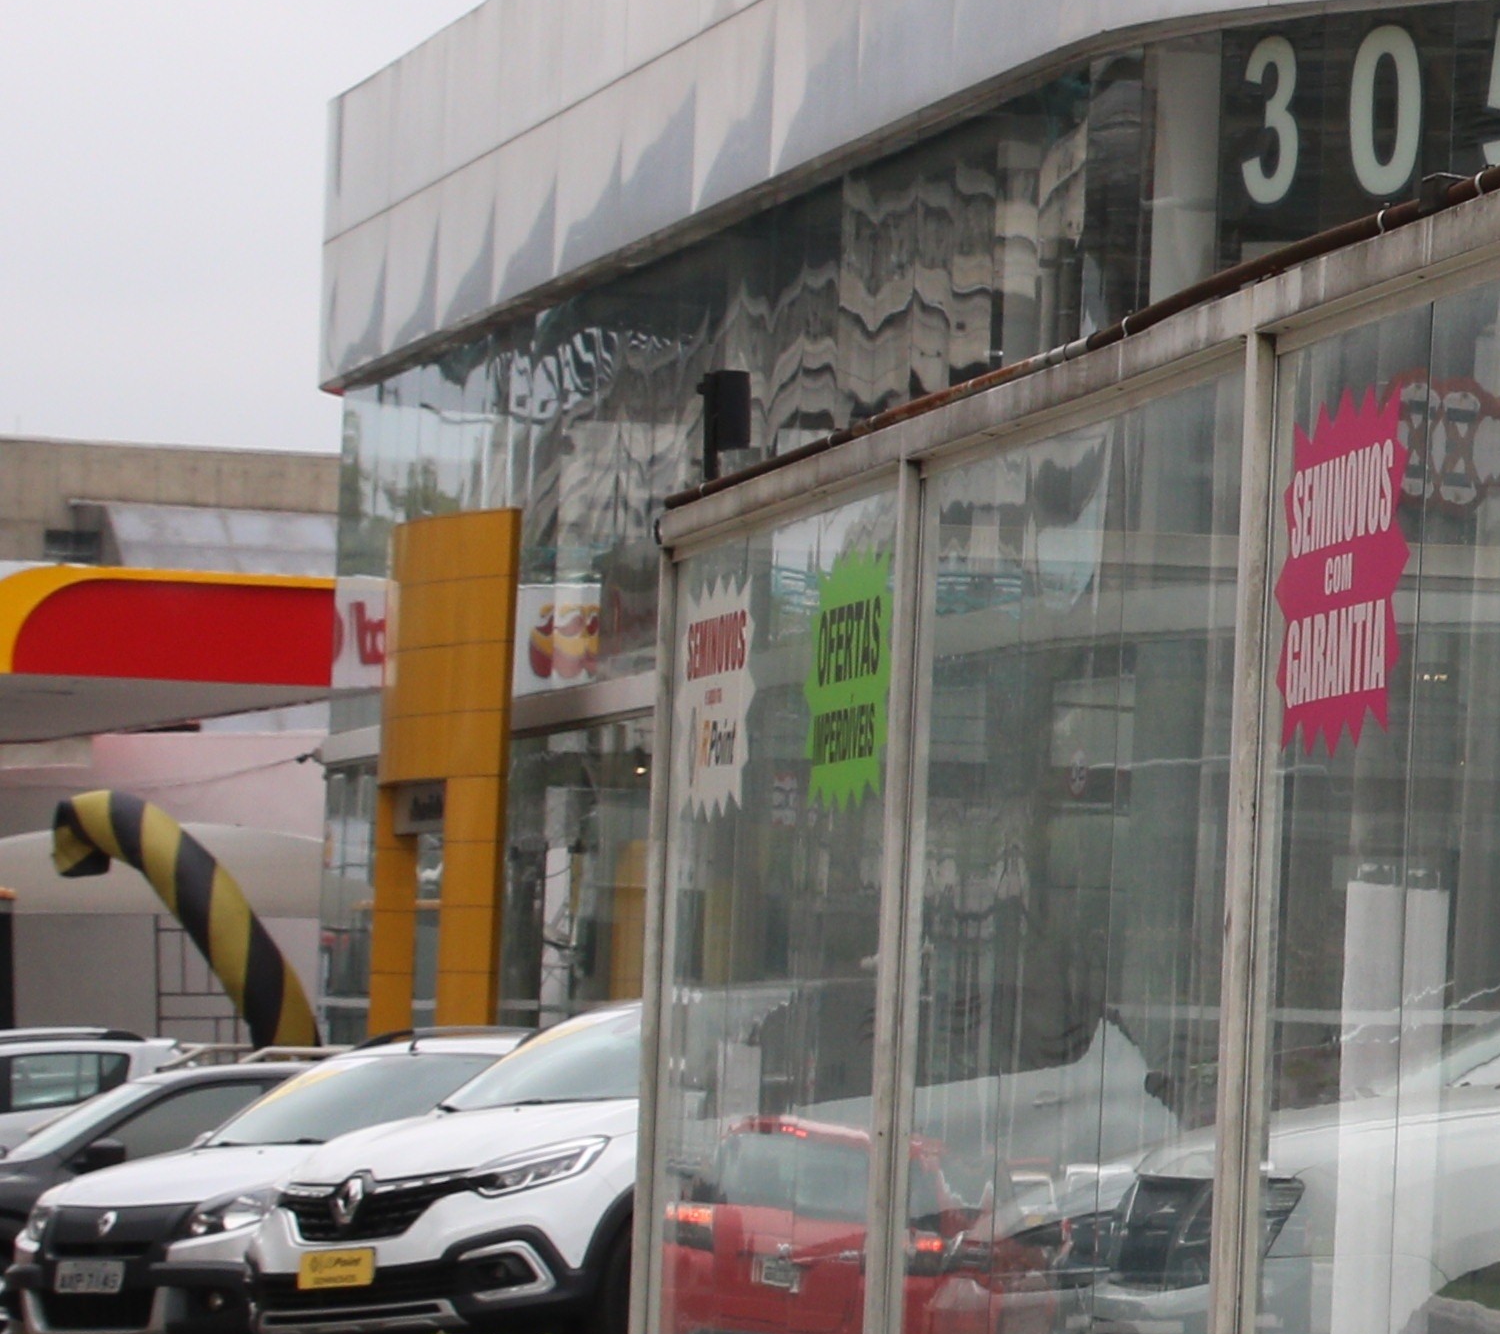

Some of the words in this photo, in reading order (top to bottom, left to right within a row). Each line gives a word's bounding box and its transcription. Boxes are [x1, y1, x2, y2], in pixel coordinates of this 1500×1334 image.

[1291, 438, 1394, 559] SEMINOVOS
[1324, 552, 1353, 595] COM
[686, 609, 747, 682] SEMINOVOS
[817, 595, 882, 687] OFERTAS
[1285, 598, 1386, 709] GARANTIA
[812, 693, 876, 766] IMPERDÍVEIS
